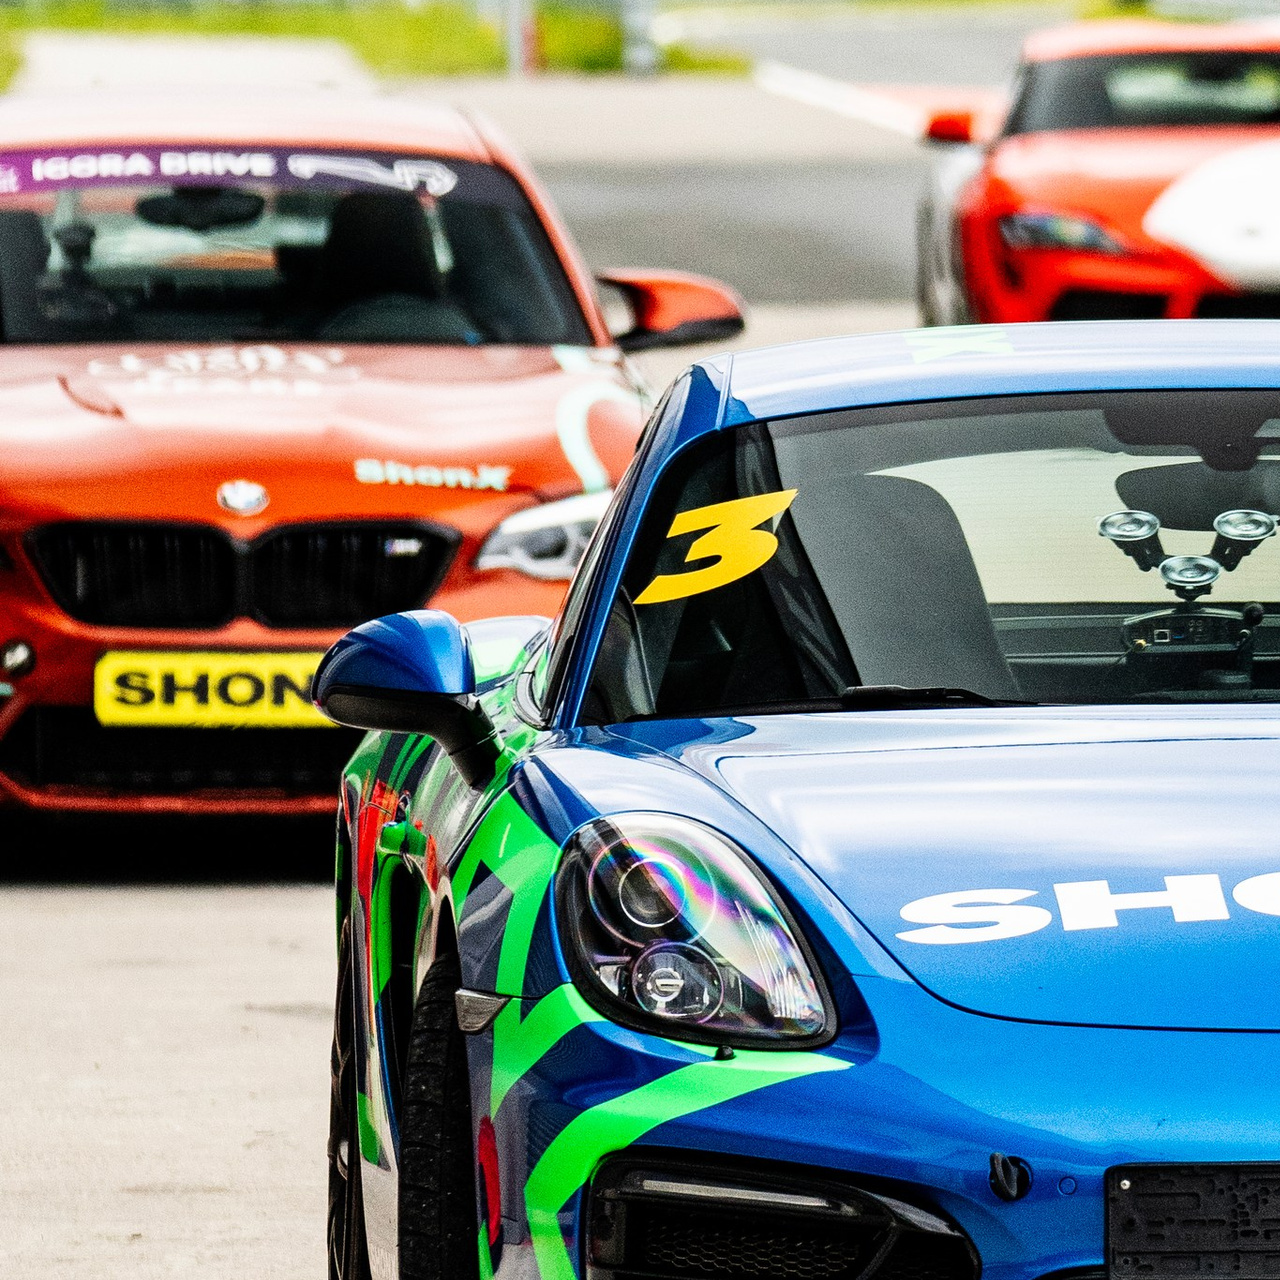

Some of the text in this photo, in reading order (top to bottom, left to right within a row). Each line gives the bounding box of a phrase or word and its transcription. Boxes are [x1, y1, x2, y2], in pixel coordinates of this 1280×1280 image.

[32, 153, 153, 180] IGORA
[160, 152, 276, 177] DRIVE
[632, 489, 798, 604] 3
[114, 672, 313, 706] SHON
